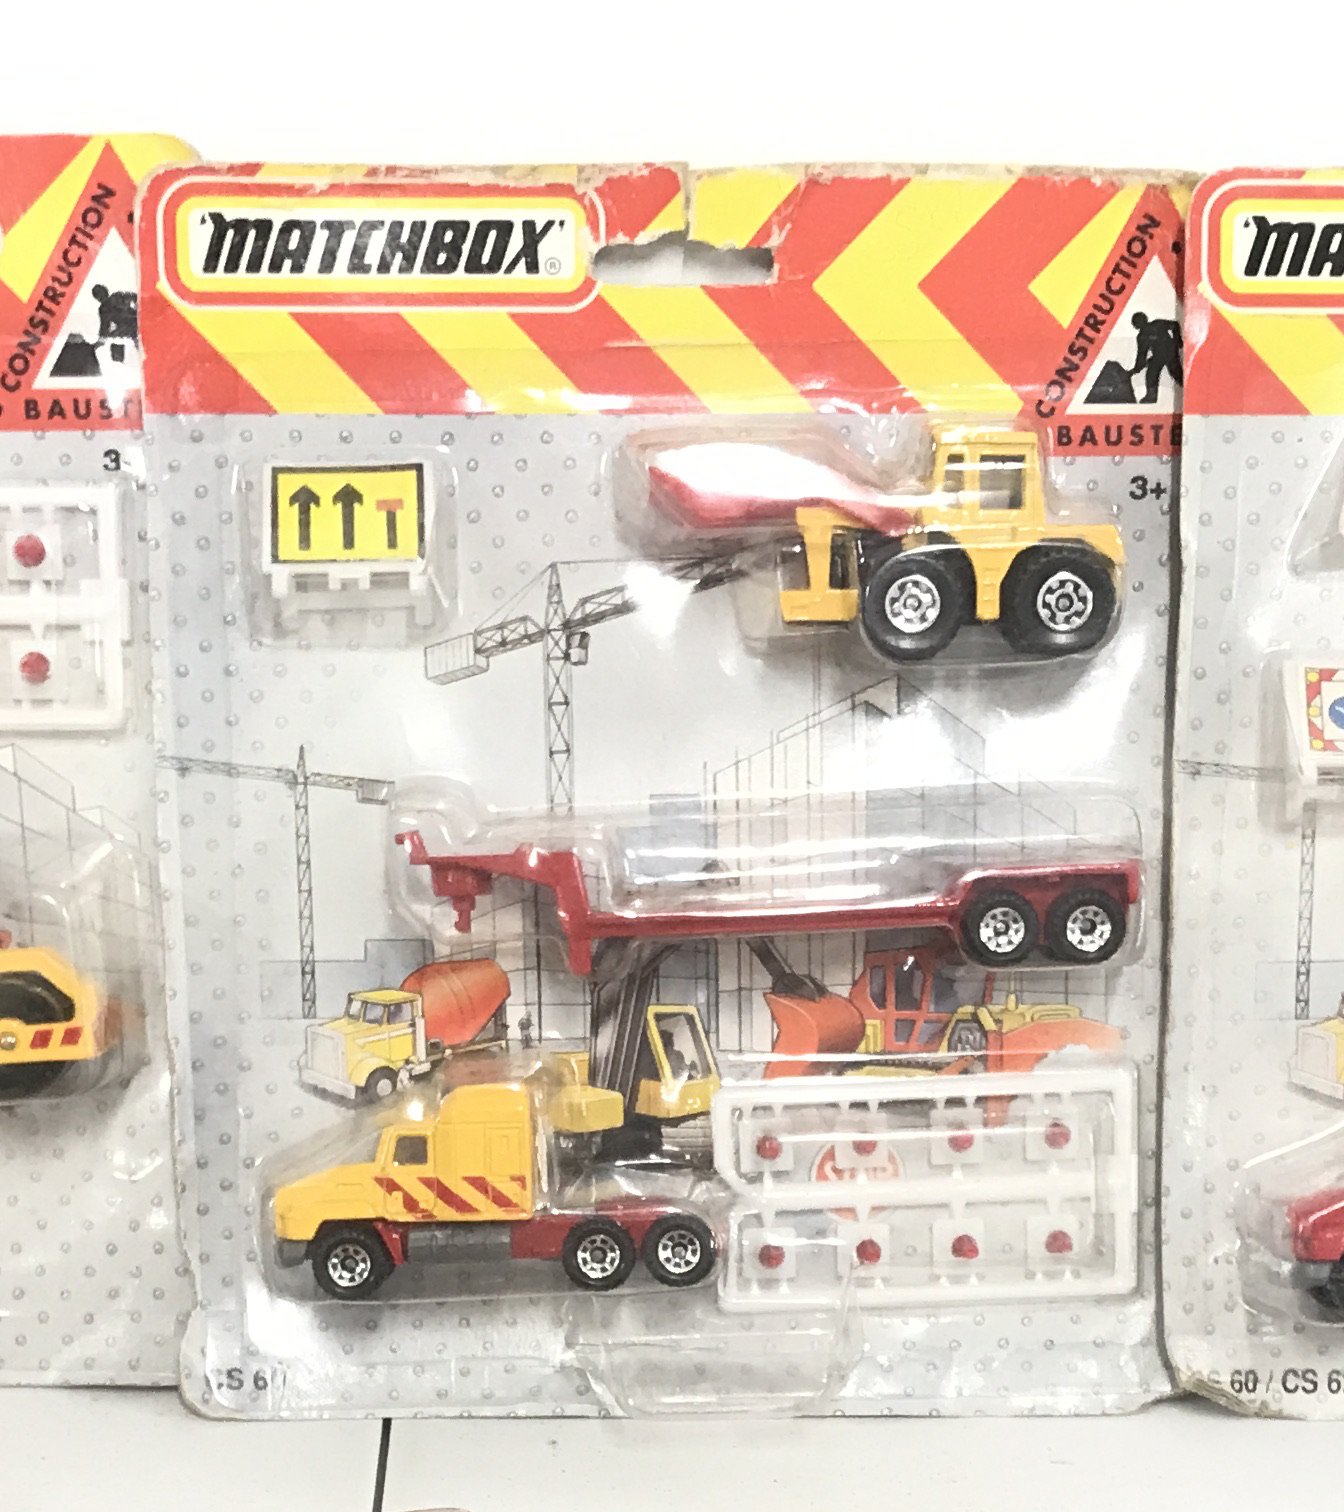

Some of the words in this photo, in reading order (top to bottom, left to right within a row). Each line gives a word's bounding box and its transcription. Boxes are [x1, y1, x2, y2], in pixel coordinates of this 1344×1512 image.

[200, 211, 565, 275] MATCHBOX
[0, 182, 117, 393] CONSTRUCTION
[1035, 212, 1162, 419] CONSTRUCTION
[1128, 474, 1168, 502] 3+
[1229, 1369, 1259, 1394] 60
[1281, 1367, 1320, 1395] CS
